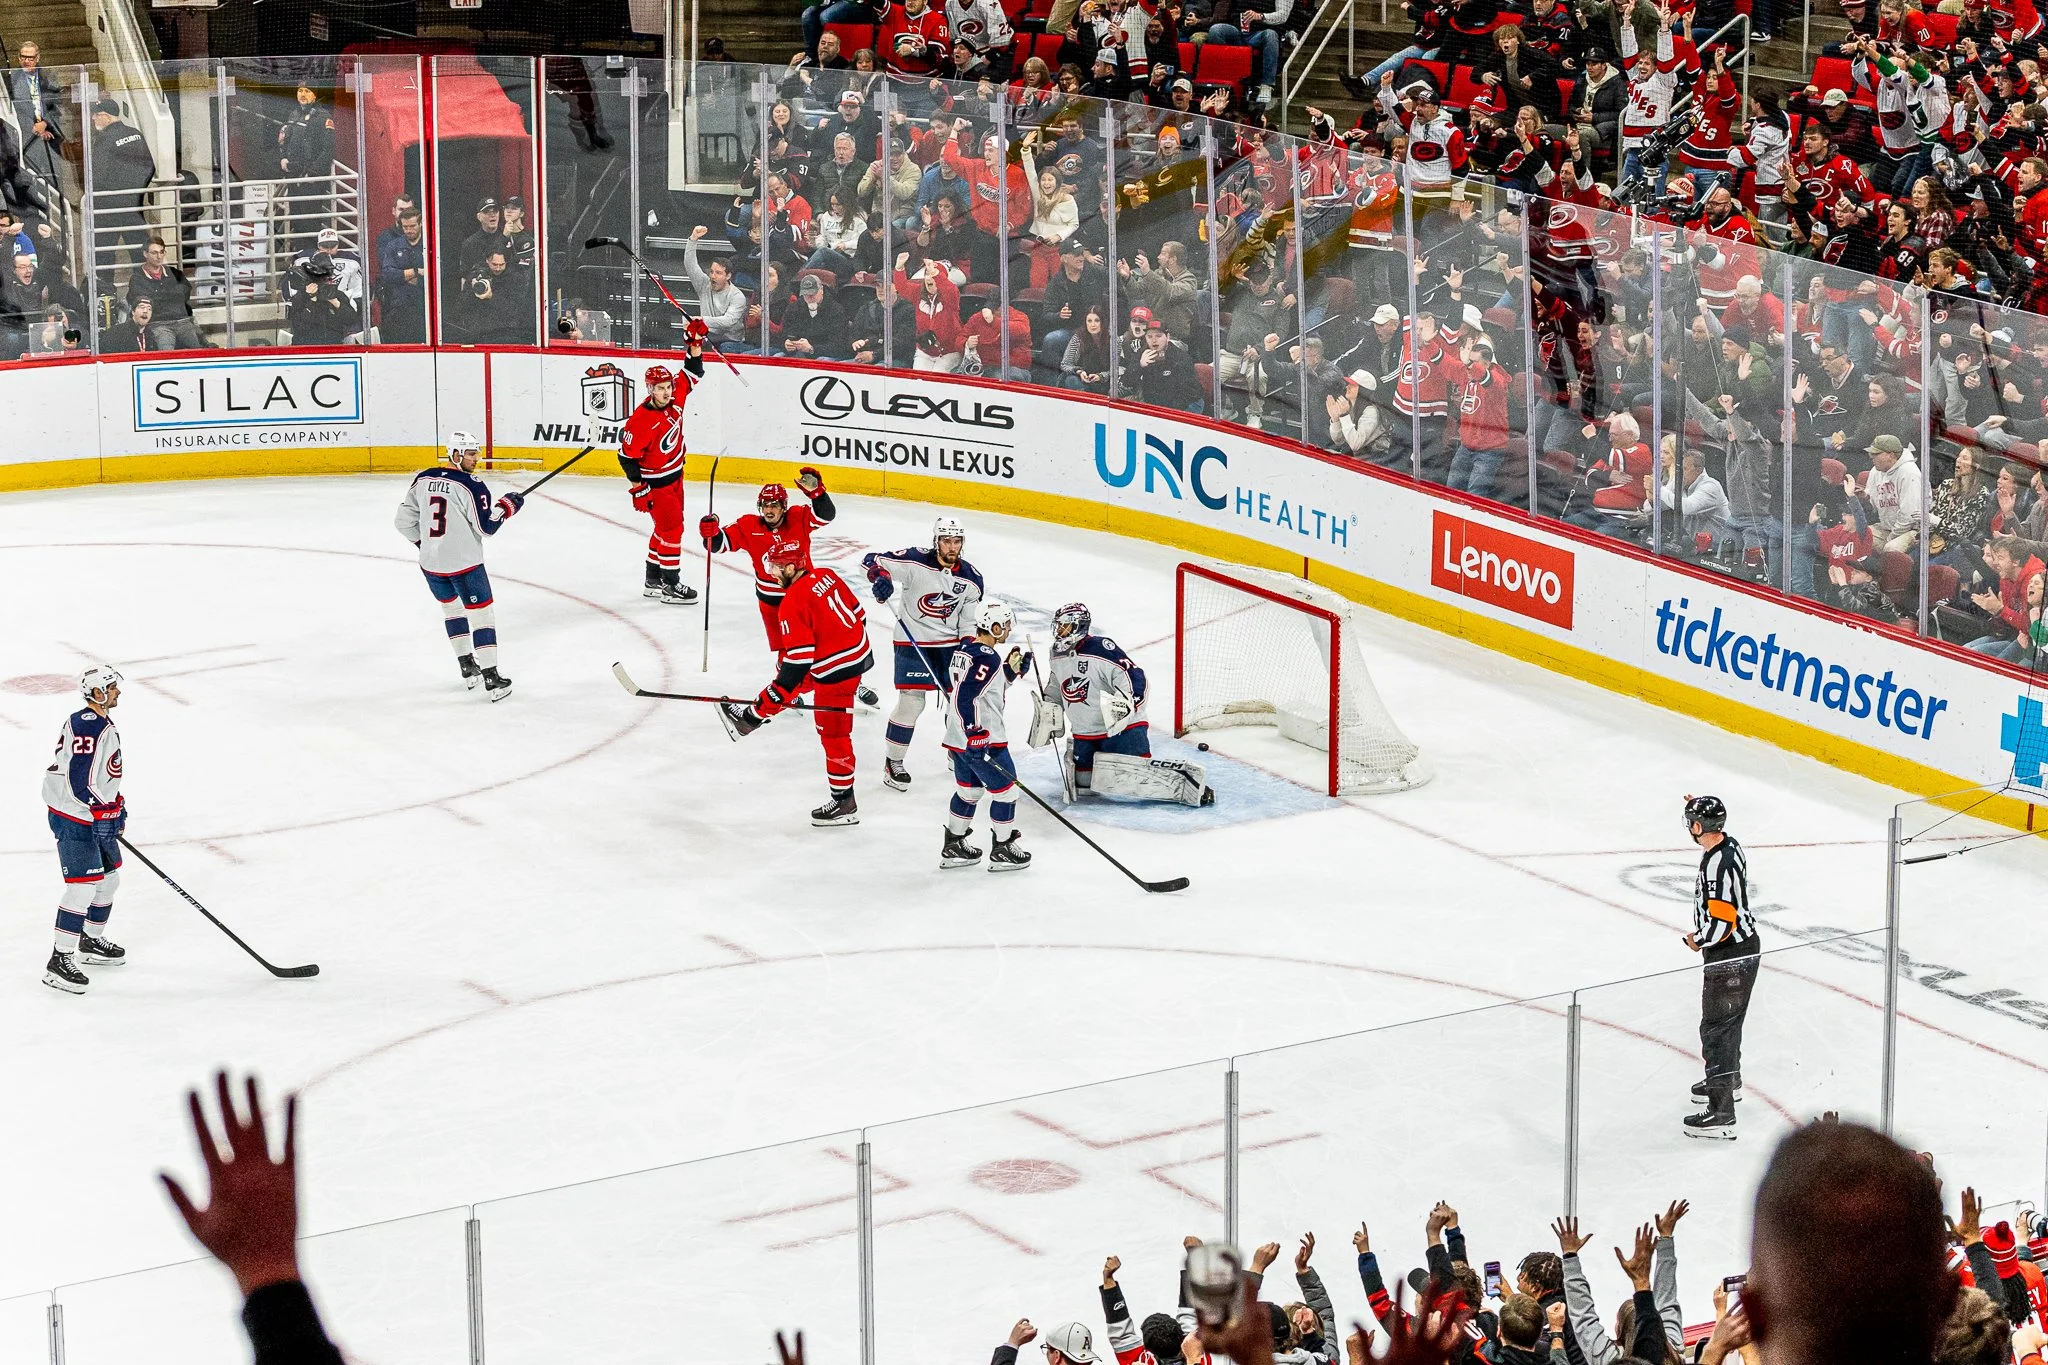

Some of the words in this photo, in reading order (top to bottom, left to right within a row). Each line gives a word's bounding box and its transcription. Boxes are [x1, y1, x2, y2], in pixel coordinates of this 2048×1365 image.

[938, 25, 948, 38] 37
[1917, 28, 1931, 42] 20
[799, 164, 809, 176] 37
[1854, 175, 1867, 192] 17
[1897, 250, 1915, 267] 89
[155, 374, 341, 414] SILAC
[861, 389, 1015, 430] LEXUS
[156, 433, 251, 448] INSURANCE
[801, 435, 929, 468] JOHNSON
[939, 448, 1015, 479] LEXUS
[1094, 423, 1228, 510] UNC
[430, 480, 451, 494] COYLE
[481, 495, 489, 510] 3
[429, 496, 448, 538] 3
[1443, 530, 1562, 604] Lenovo
[812, 574, 841, 597] STAAL
[827, 588, 858, 629] 11
[780, 619, 790, 636] 11
[974, 663, 990, 681] 5
[1655, 597, 1949, 741] ticketmaster
[73, 735, 95, 754] 23
[1150, 759, 1184, 770] CCM
[1081, 1336, 1091, 1350] A
